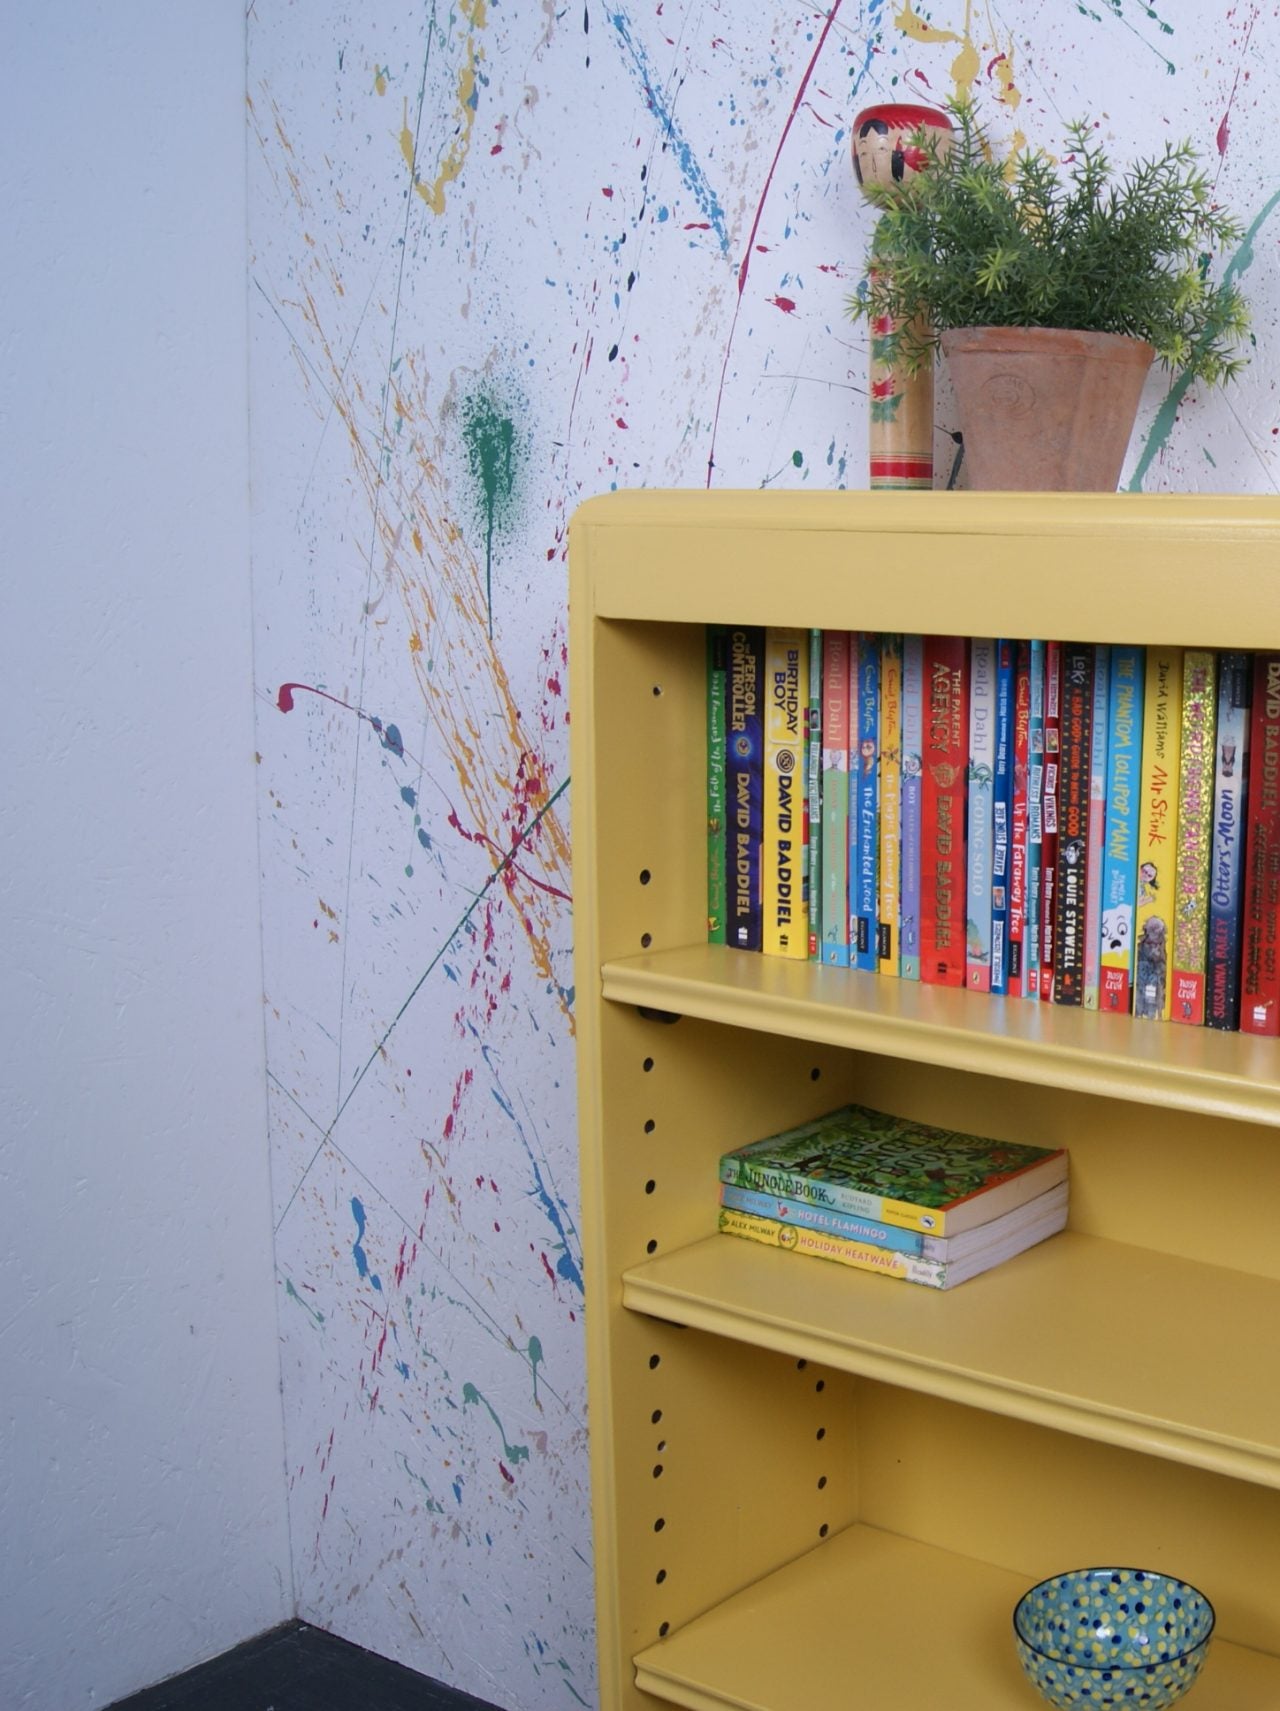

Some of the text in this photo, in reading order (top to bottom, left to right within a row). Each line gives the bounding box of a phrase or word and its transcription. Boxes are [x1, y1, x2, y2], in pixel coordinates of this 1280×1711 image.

[710, 672, 720, 697] Tree
[732, 632, 746, 732] CONTROLLER
[744, 655, 756, 716] PERSON
[774, 672, 787, 711] BOY
[786, 650, 799, 736] BIRTHDAY
[828, 640, 842, 741] Roald Dahl
[862, 664, 875, 733] Enid Blyton
[885, 668, 897, 736] Enid Blyton
[930, 661, 951, 753] AGENCY
[951, 669, 962, 748] THE PARENT
[973, 645, 989, 752] Roald Dahl
[1072, 696, 1083, 716] BAD
[1190, 667, 1207, 694] THE
[710, 698, 721, 743] Faraway
[906, 704, 919, 749] Dahl
[1016, 676, 1029, 747] Enid Blyton
[1187, 701, 1206, 752] WEIRD
[1070, 744, 1080, 770] GUIDE
[1093, 722, 1105, 767] Dahl
[1108, 657, 1135, 862] THE PHANTOM LOLLIPOP MAN!
[1148, 662, 1170, 848] David Walliams Mr Stink
[1261, 724, 1280, 810] BADDIEL
[710, 775, 720, 798] Folk
[884, 791, 896, 828] Magic
[908, 785, 916, 805] BOY
[1045, 797, 1056, 829] VIKINGS
[736, 773, 750, 917] DAVID BADDIEL
[972, 794, 985, 897] GOING SOLO
[1030, 804, 1041, 840] ROMANS
[1067, 806, 1079, 836] GOOD
[1183, 821, 1201, 851] FAN
[1218, 789, 1235, 847] Moon
[777, 775, 792, 927] DAVID BADDIEL
[862, 787, 874, 912] The Enchanted Wood
[884, 832, 897, 889] Faraway
[935, 795, 953, 951] DAVID BADDIEL
[1010, 802, 1025, 934] Up The Faraway Tree
[1182, 856, 1200, 895] CLUB
[884, 892, 895, 919] Tree
[1064, 868, 1078, 969] LOUIE STOWELL
[1213, 917, 1229, 1018] SUSANNA BAILEY
[746, 1168, 793, 1193] JUNGLE
[795, 1180, 836, 1205] BOOK
[731, 1220, 776, 1236] ALEX MILWAY
[798, 1209, 887, 1240] HOTEL FLAMINGO
[800, 1236, 899, 1270] HOLIDAY HEATWAVE
